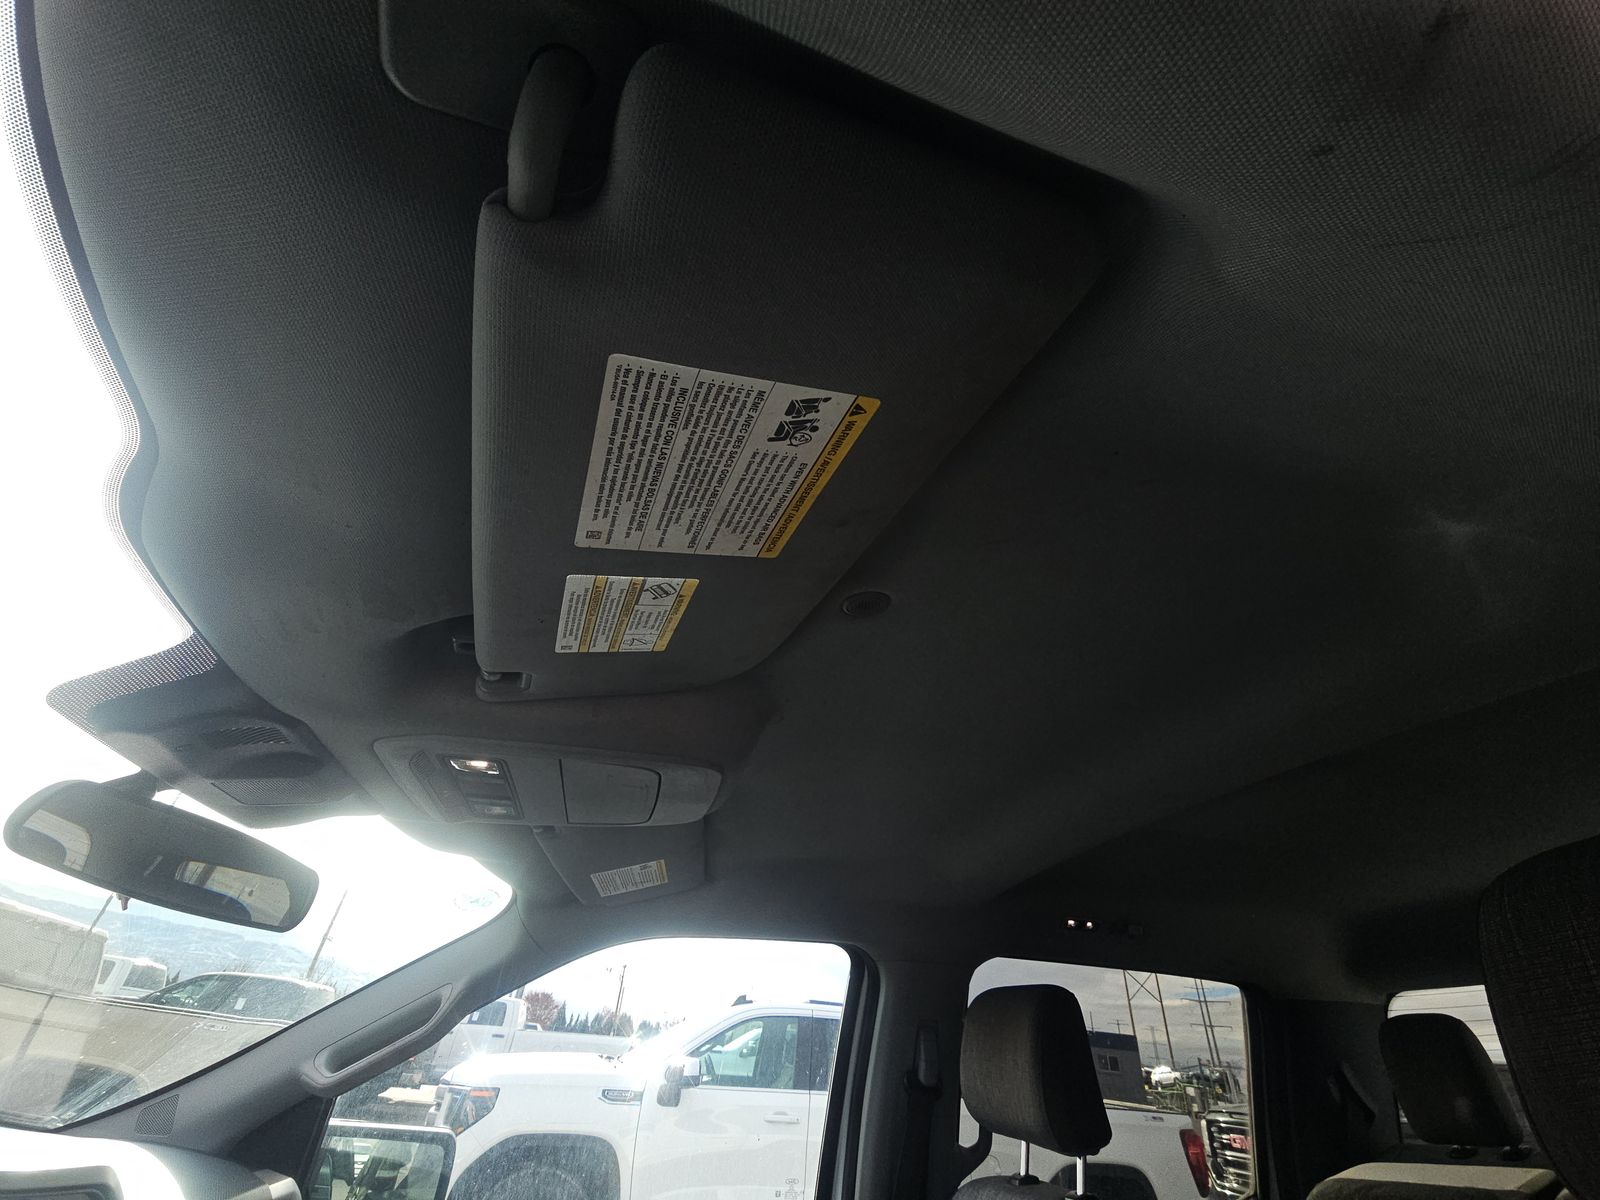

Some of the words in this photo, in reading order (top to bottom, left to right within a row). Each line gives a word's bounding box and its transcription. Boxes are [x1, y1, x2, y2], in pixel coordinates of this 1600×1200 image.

[666, 386, 689, 429] INCLUSIVE
[747, 389, 767, 414] MÊME
[738, 413, 756, 434] AVEC
[825, 419, 858, 456] WARNING
[722, 449, 739, 468] SACS
[791, 462, 808, 479] EVEN
[648, 461, 664, 487] NUEVAS
[705, 468, 731, 507] GONFLABLES
[782, 479, 798, 494] WITH
[640, 487, 656, 511] BOLSAS
[765, 494, 789, 523] ADVANCED
[634, 519, 646, 532] AIRE
[751, 531, 766, 545] BAGS
